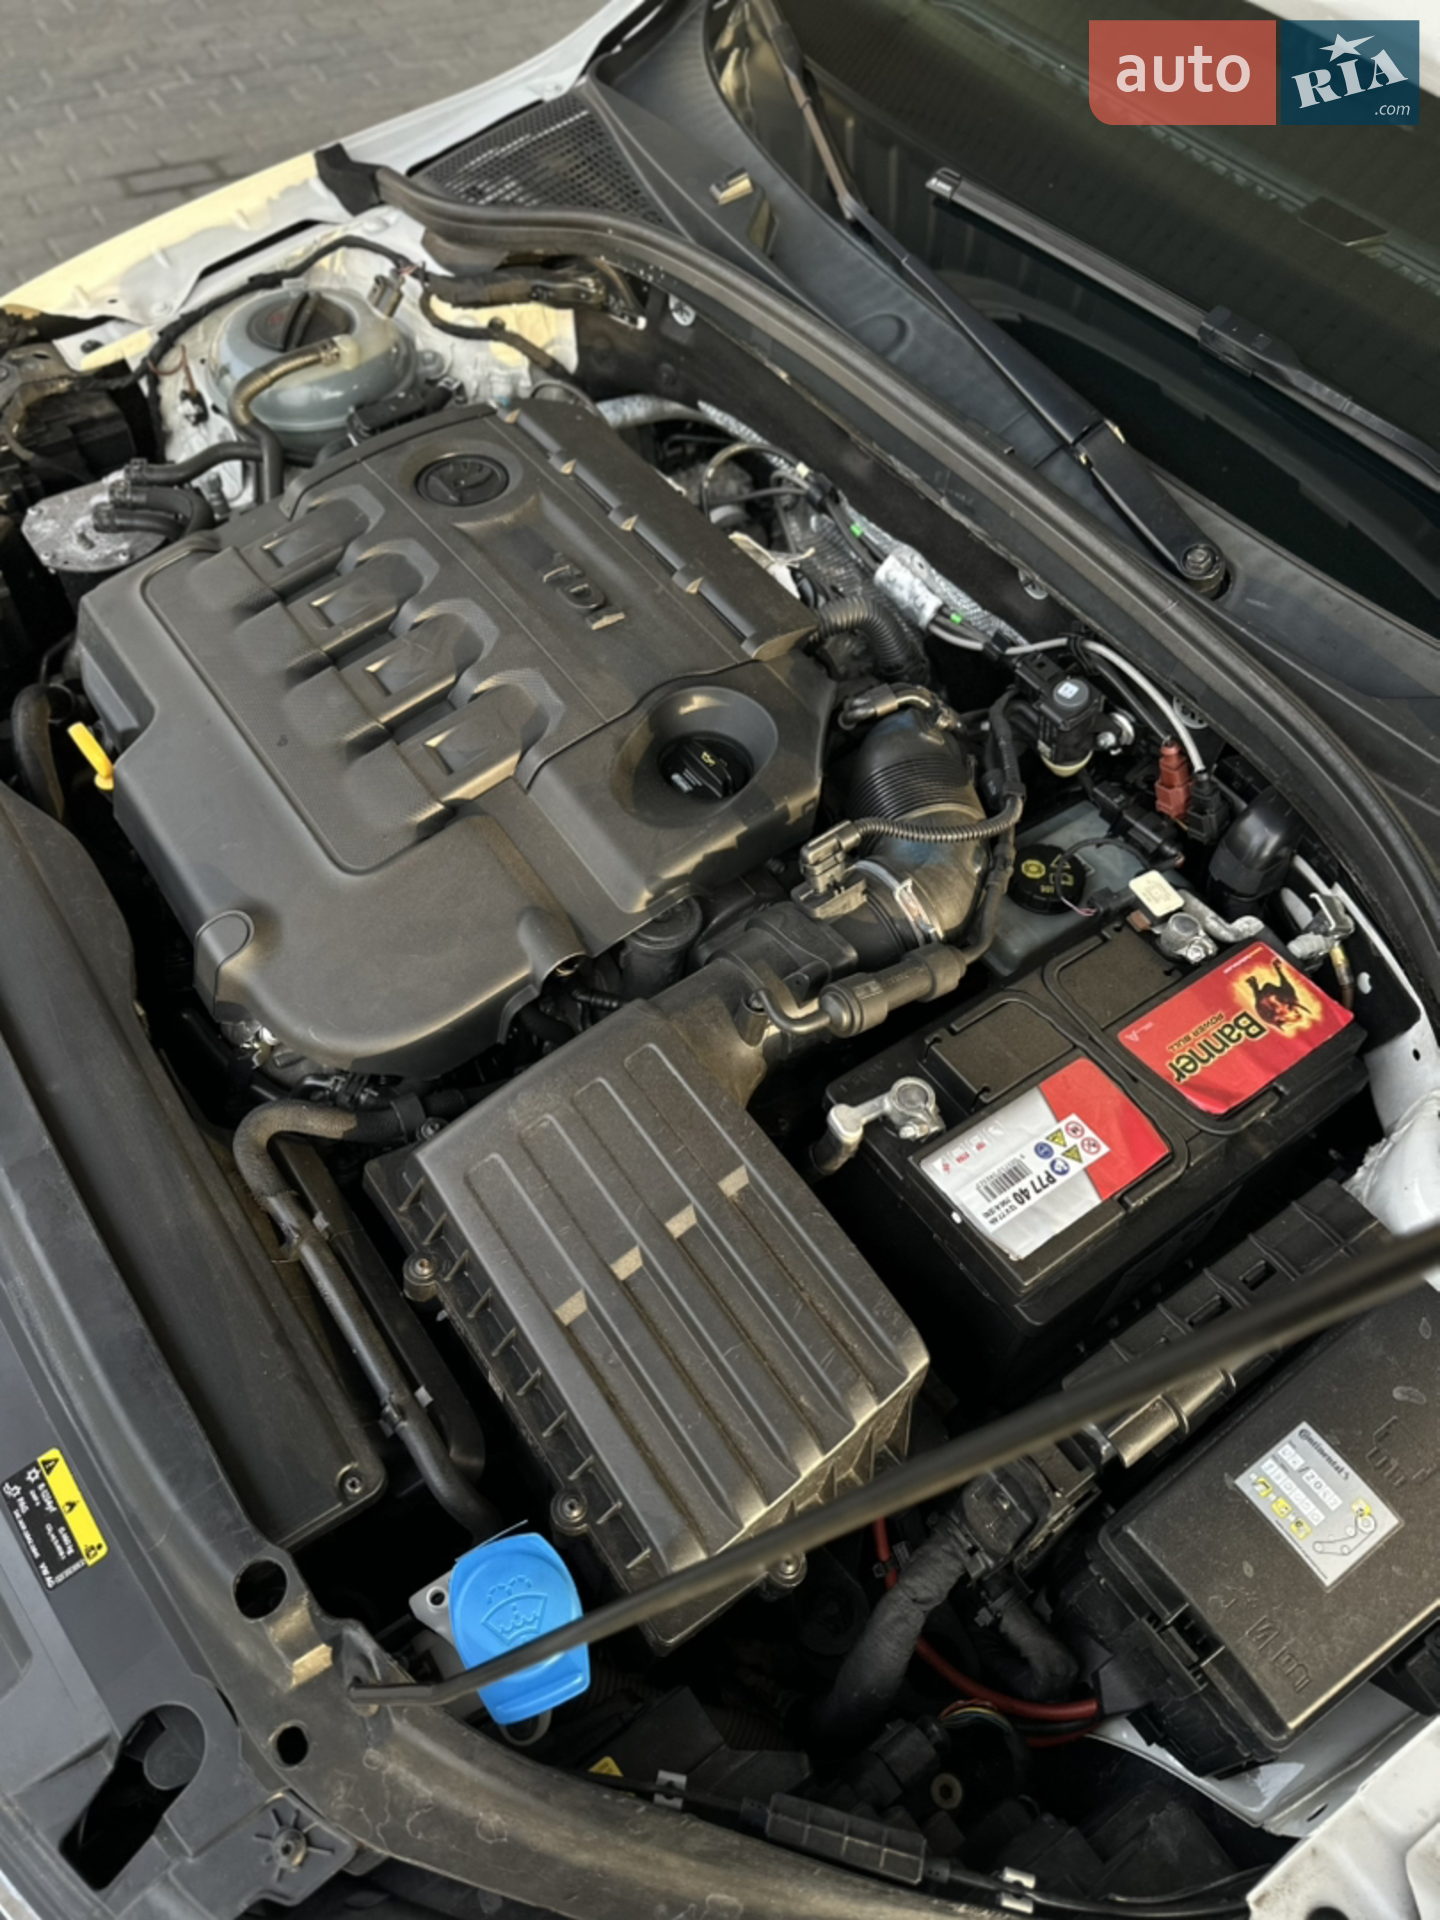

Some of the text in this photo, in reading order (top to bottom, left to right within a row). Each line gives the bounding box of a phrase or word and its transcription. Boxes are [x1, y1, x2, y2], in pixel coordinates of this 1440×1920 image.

[542, 558, 626, 631] TDI
[1166, 1011, 1266, 1082] Banner
[1167, 1011, 1224, 1053] POWER BULL
[1012, 1186, 1031, 1205] 40
[1030, 1170, 1057, 1194] P77
